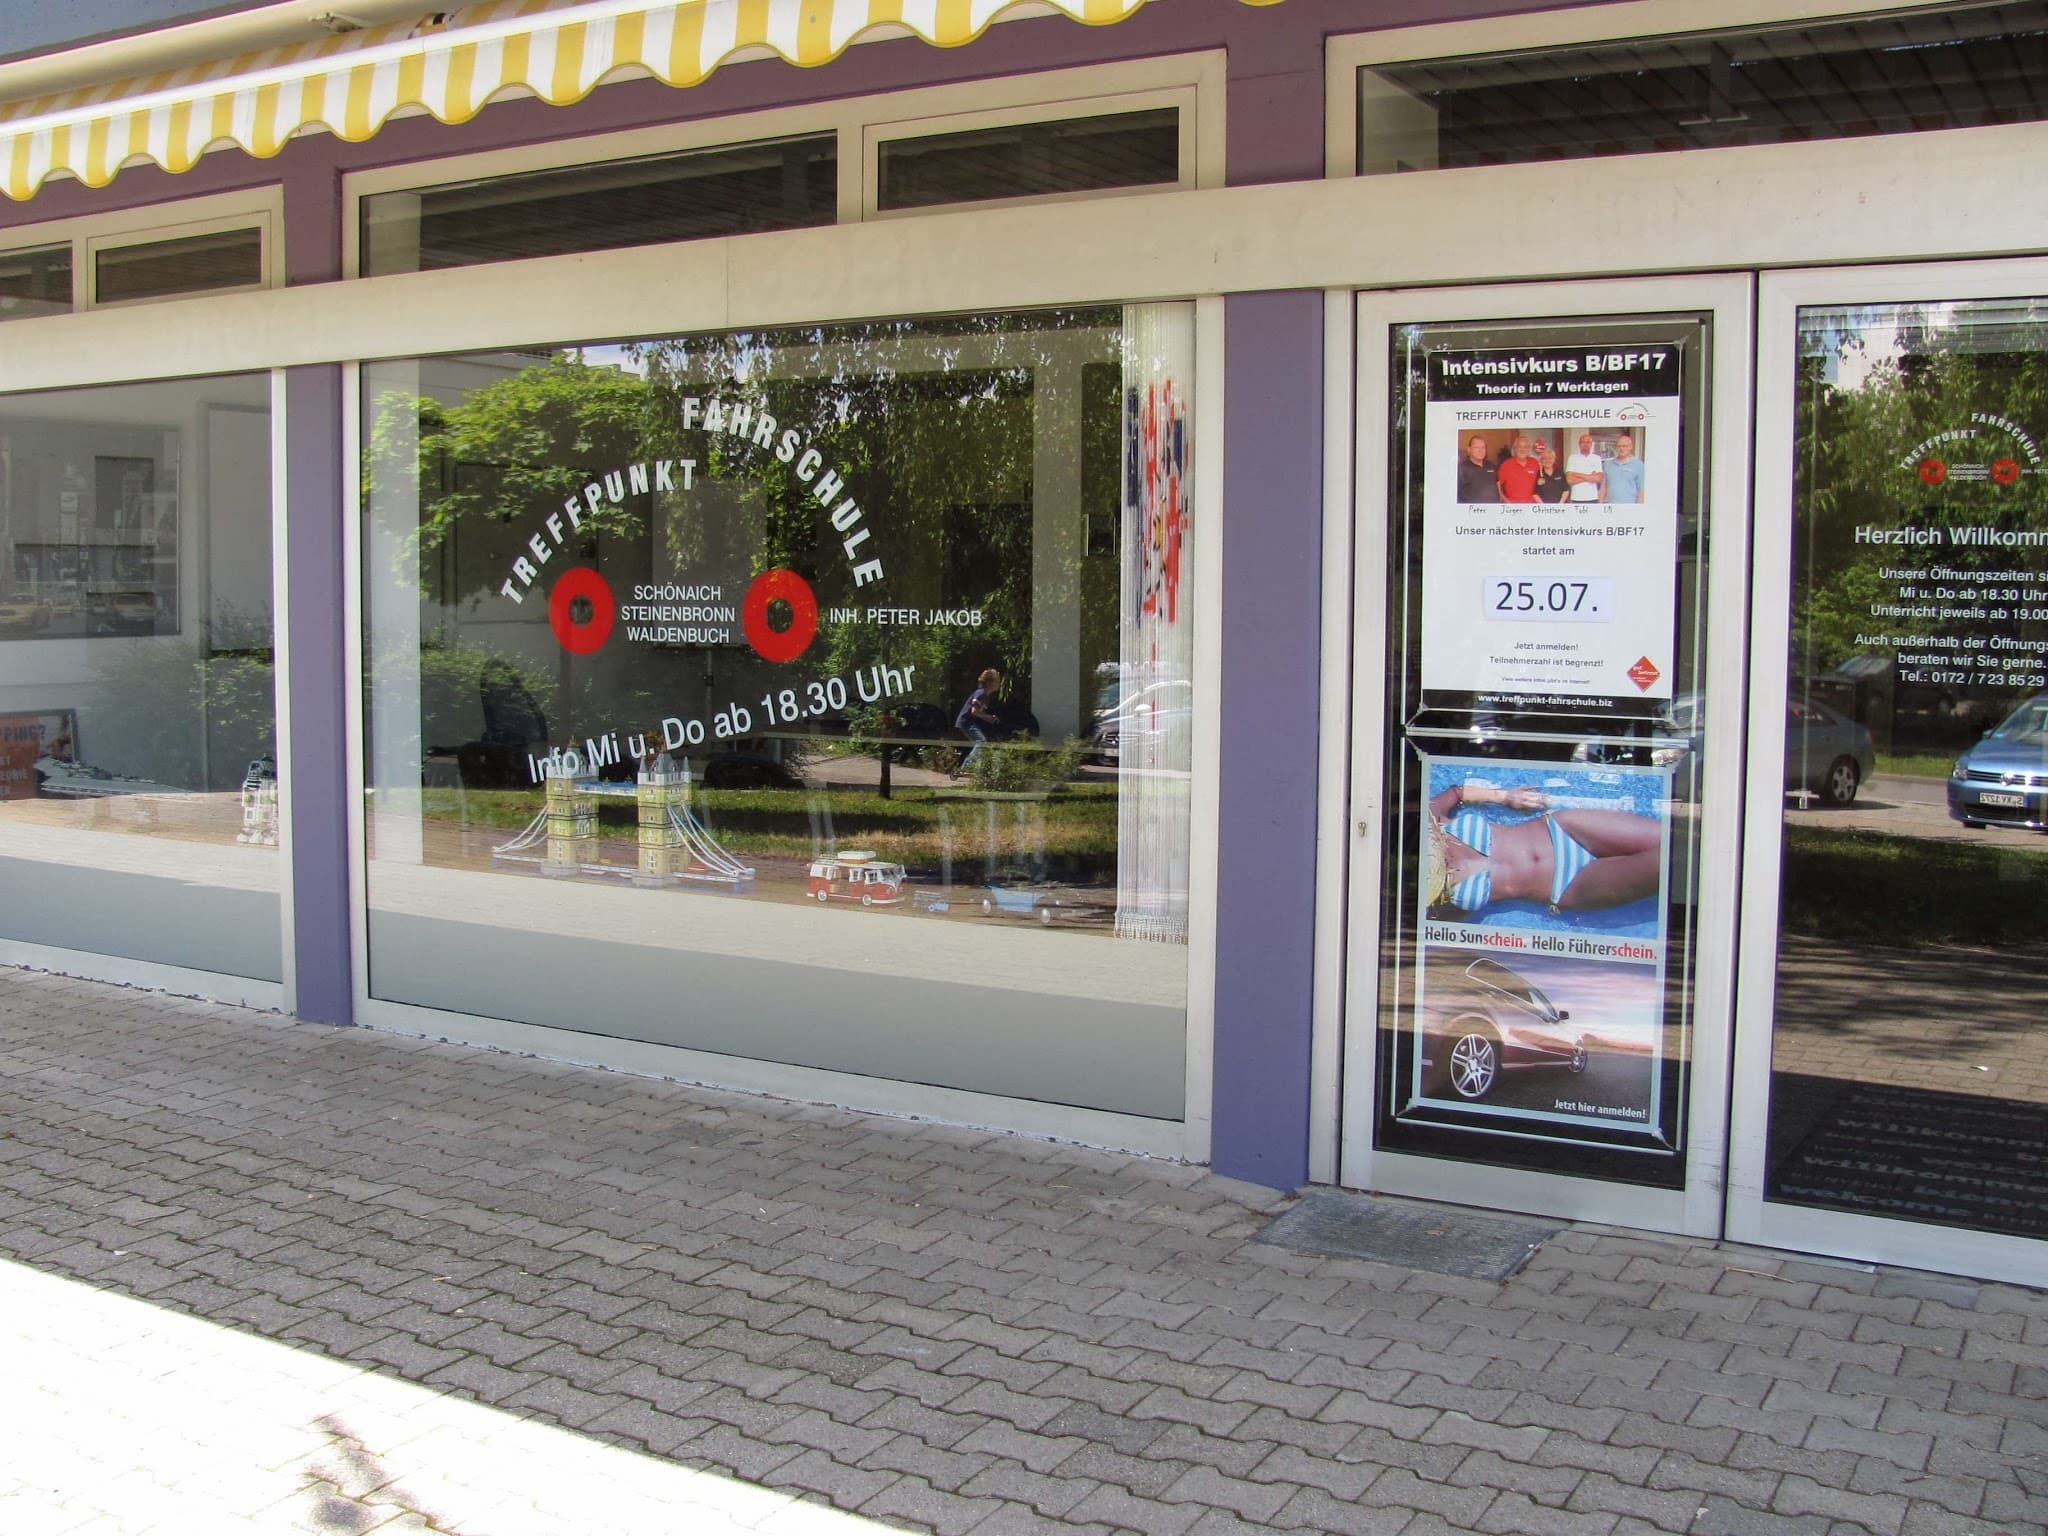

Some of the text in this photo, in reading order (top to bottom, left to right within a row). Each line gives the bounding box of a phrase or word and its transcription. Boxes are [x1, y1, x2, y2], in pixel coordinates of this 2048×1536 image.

[1442, 353, 1667, 376] Intensivkurs B/BF17
[1476, 381, 1629, 395] Theorie in 7 Werktagen
[1456, 410, 1529, 422] TREFFPUNKT
[1534, 408, 1611, 420] FAHRSCHULE
[1971, 412, 2041, 465] FAHRSCHULE
[1900, 429, 1977, 471] TREFFPUNKT
[683, 397, 884, 588] FAHRSCHULE
[500, 458, 697, 605] TREFFPUNKT
[1455, 525, 1645, 538] Unser nächster Intensivkurs B/BF17
[1854, 526, 1942, 545] Herzlich
[1522, 546, 1575, 556] startet am
[1879, 567, 1926, 580] Unsere
[1930, 565, 2034, 584] Öffnungszeiten
[633, 581, 722, 602] SCHÖNAICH
[1495, 581, 1599, 612] 25.07.
[1899, 587, 2048, 602] Mi u. Do ab 18.30 Uhr
[621, 605, 736, 623] STEINENBRONN
[829, 607, 983, 627] INH. PETER JAKOB
[1870, 604, 1936, 618] Unterricht
[1938, 605, 1986, 620] jeweils
[1990, 608, 2007, 620] ab
[627, 626, 731, 645] WALDENBUCH
[1854, 633, 1888, 646] Auch
[1892, 634, 1959, 649] außerhalb
[1963, 636, 1986, 649] der
[1514, 641, 1579, 652] Jetzt anmelden!
[1489, 656, 1604, 669] Teilnehmerzahl ist begrenzt!
[1897, 653, 2047, 671] beraten wir Sie gerne.
[1900, 670, 1928, 684] Tel.:
[1931, 671, 1964, 684] 0172
[1477, 694, 1614, 707] www.treffpunkt-fahrschule.biz
[527, 664, 916, 784] Info Mi u. Do ab 18.30 Uhr
[1425, 926, 1657, 960] Hello Sunschein. Hello Führerschein.
[1554, 1099, 1647, 1119] Jetzt hier anmelden!
